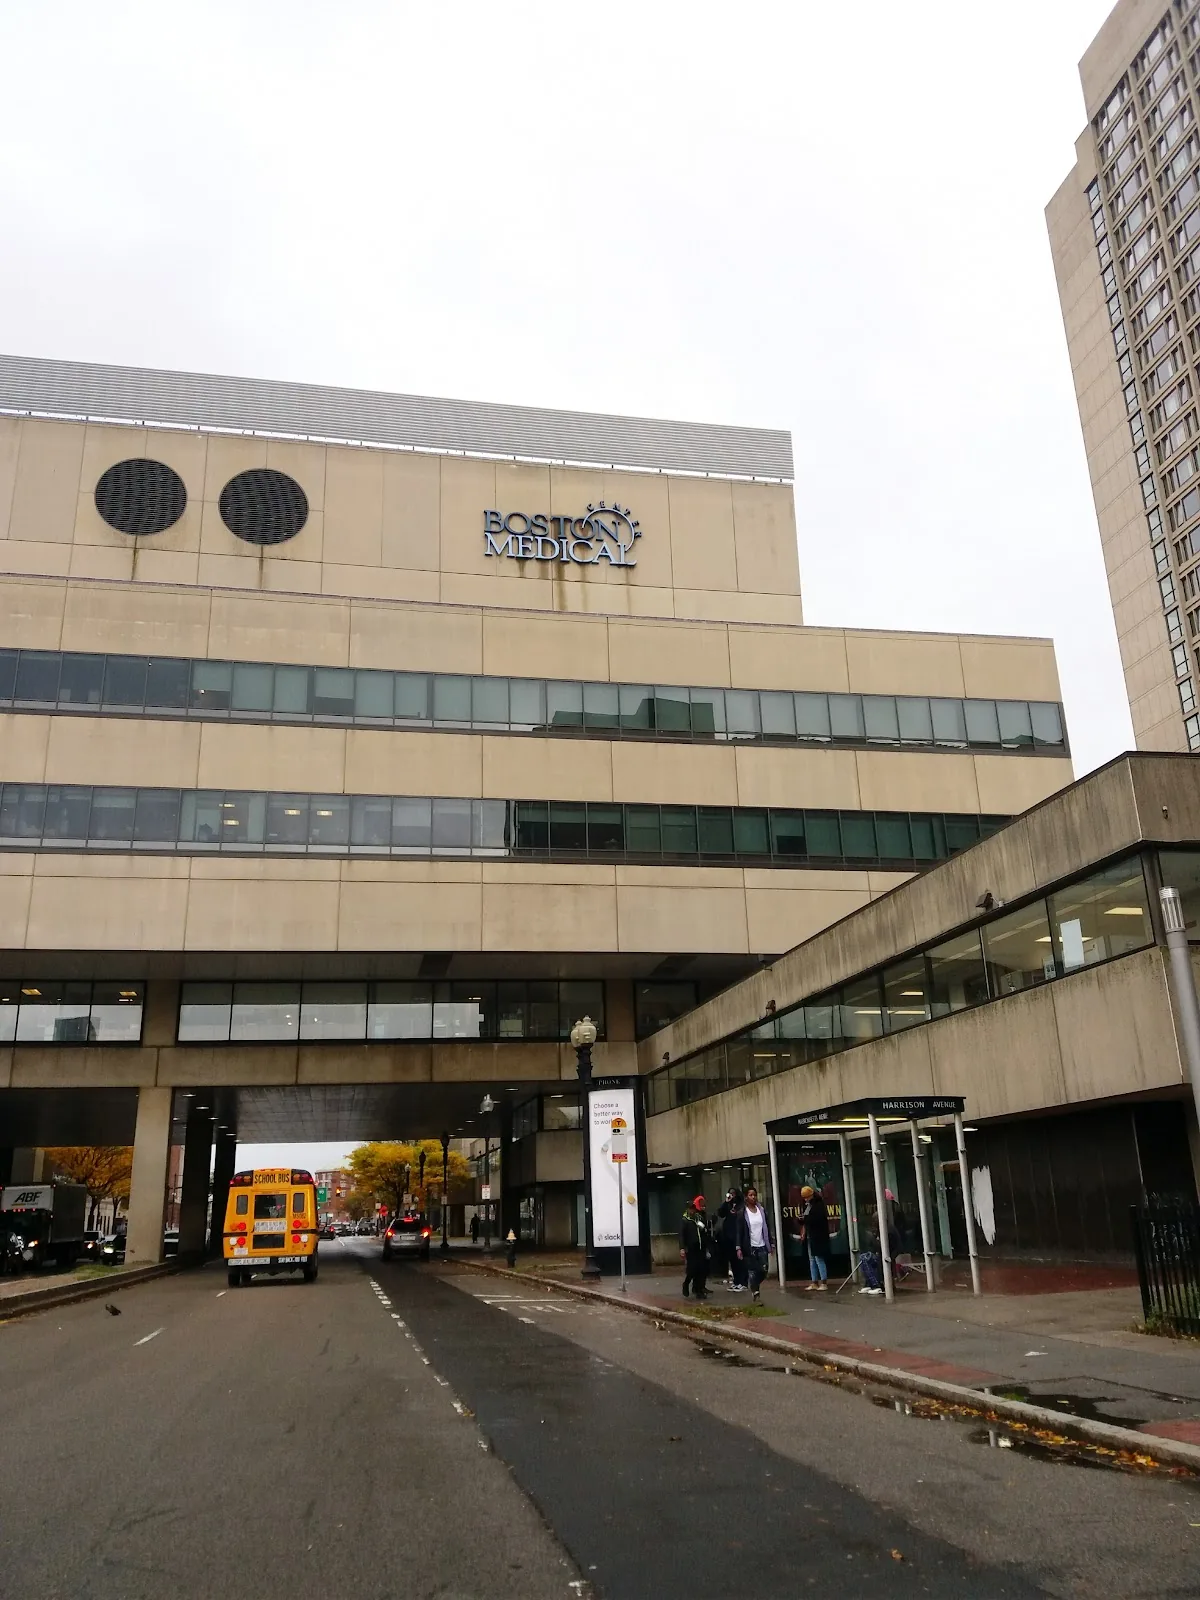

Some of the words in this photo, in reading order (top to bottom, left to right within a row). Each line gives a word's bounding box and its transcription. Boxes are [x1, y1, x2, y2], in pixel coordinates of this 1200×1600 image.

[483, 509, 621, 543] BOSTON
[586, 500, 642, 539] CENTER
[484, 532, 638, 566] MEDICAL
[882, 1101, 925, 1109] HARRISON
[932, 1100, 957, 1109] AVENUE
[254, 1173, 277, 1184] SCHOOL
[278, 1173, 290, 1183] BUS
[15, 1191, 43, 1203] ABF
[783, 1203, 842, 1219] STUWN
